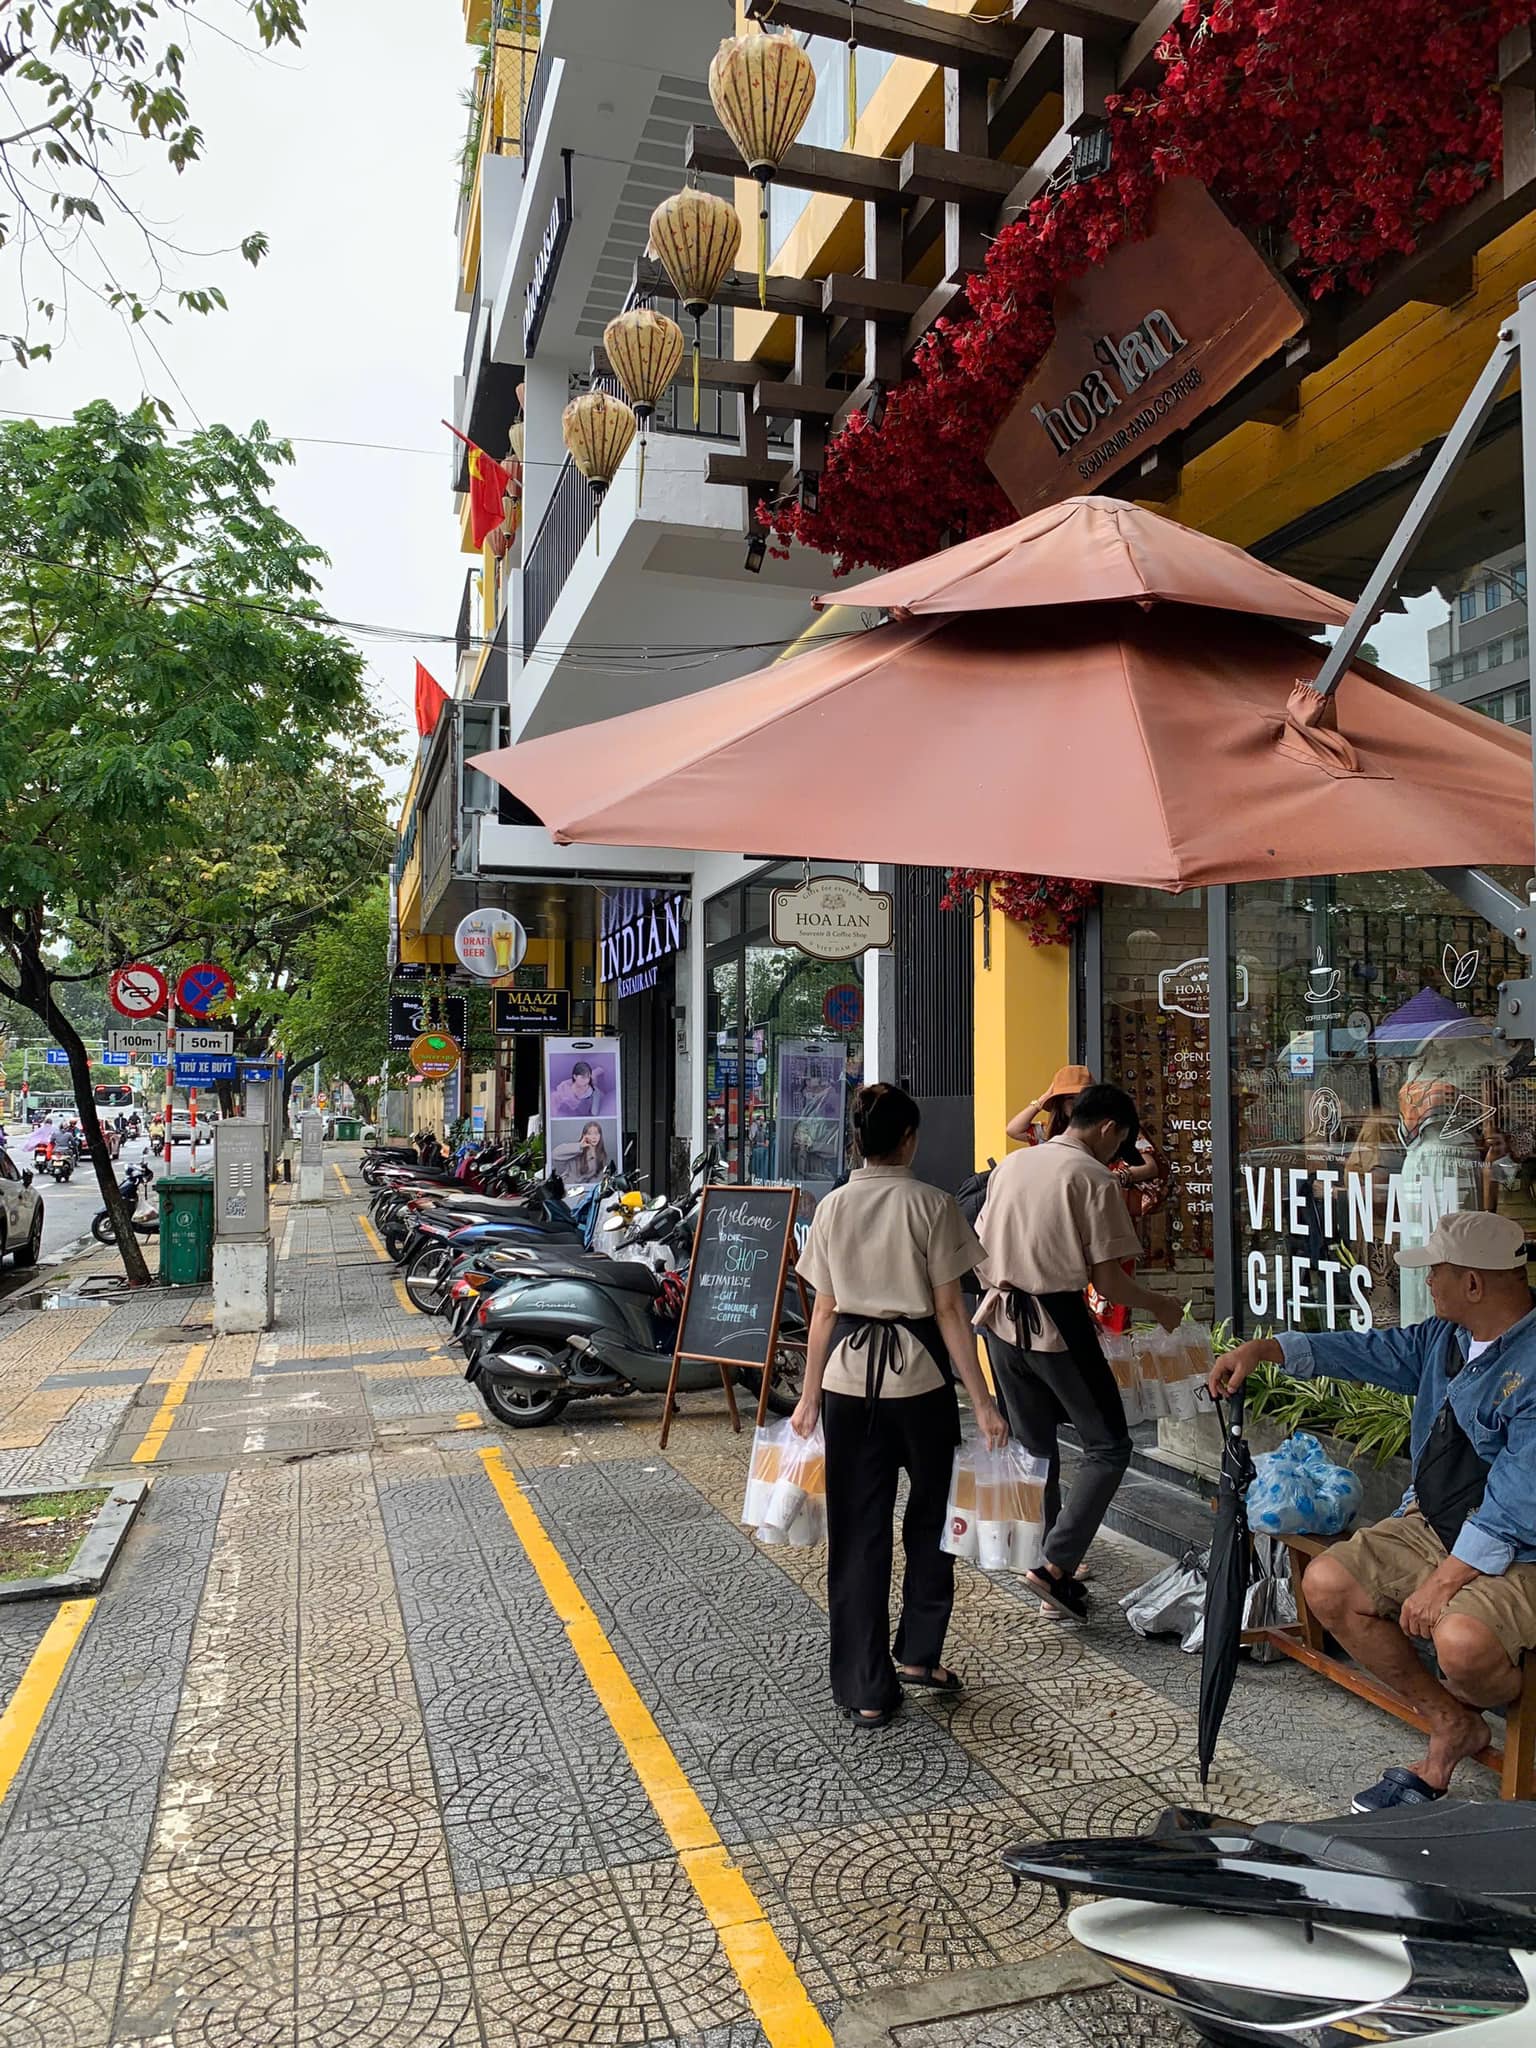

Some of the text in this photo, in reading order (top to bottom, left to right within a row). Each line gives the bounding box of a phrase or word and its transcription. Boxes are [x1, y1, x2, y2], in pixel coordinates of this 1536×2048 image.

[1030, 308, 1188, 457] hoa lan
[1077, 364, 1203, 480] SOUVENIR AND COFFEE
[796, 912, 870, 927] HOA LAN
[463, 937, 492, 946] DRAFT
[600, 895, 681, 983] INDIAN
[463, 948, 486, 957] BEER
[1175, 984, 1202, 995] HOA
[508, 992, 558, 1005] MAAZI
[121, 1035, 153, 1047] 100m
[191, 1037, 221, 1048] 50m
[1174, 1052, 1204, 1062] OPEN
[198, 1062, 210, 1073] XE
[1176, 1070, 1198, 1080] 9:00
[1244, 1166, 1458, 1248] VIETNAM
[706, 1201, 780, 1231] Welcome
[725, 1244, 768, 1272] SHOP
[700, 1273, 751, 1288] VIETNAMESE
[1247, 1250, 1373, 1333] GIFTS
